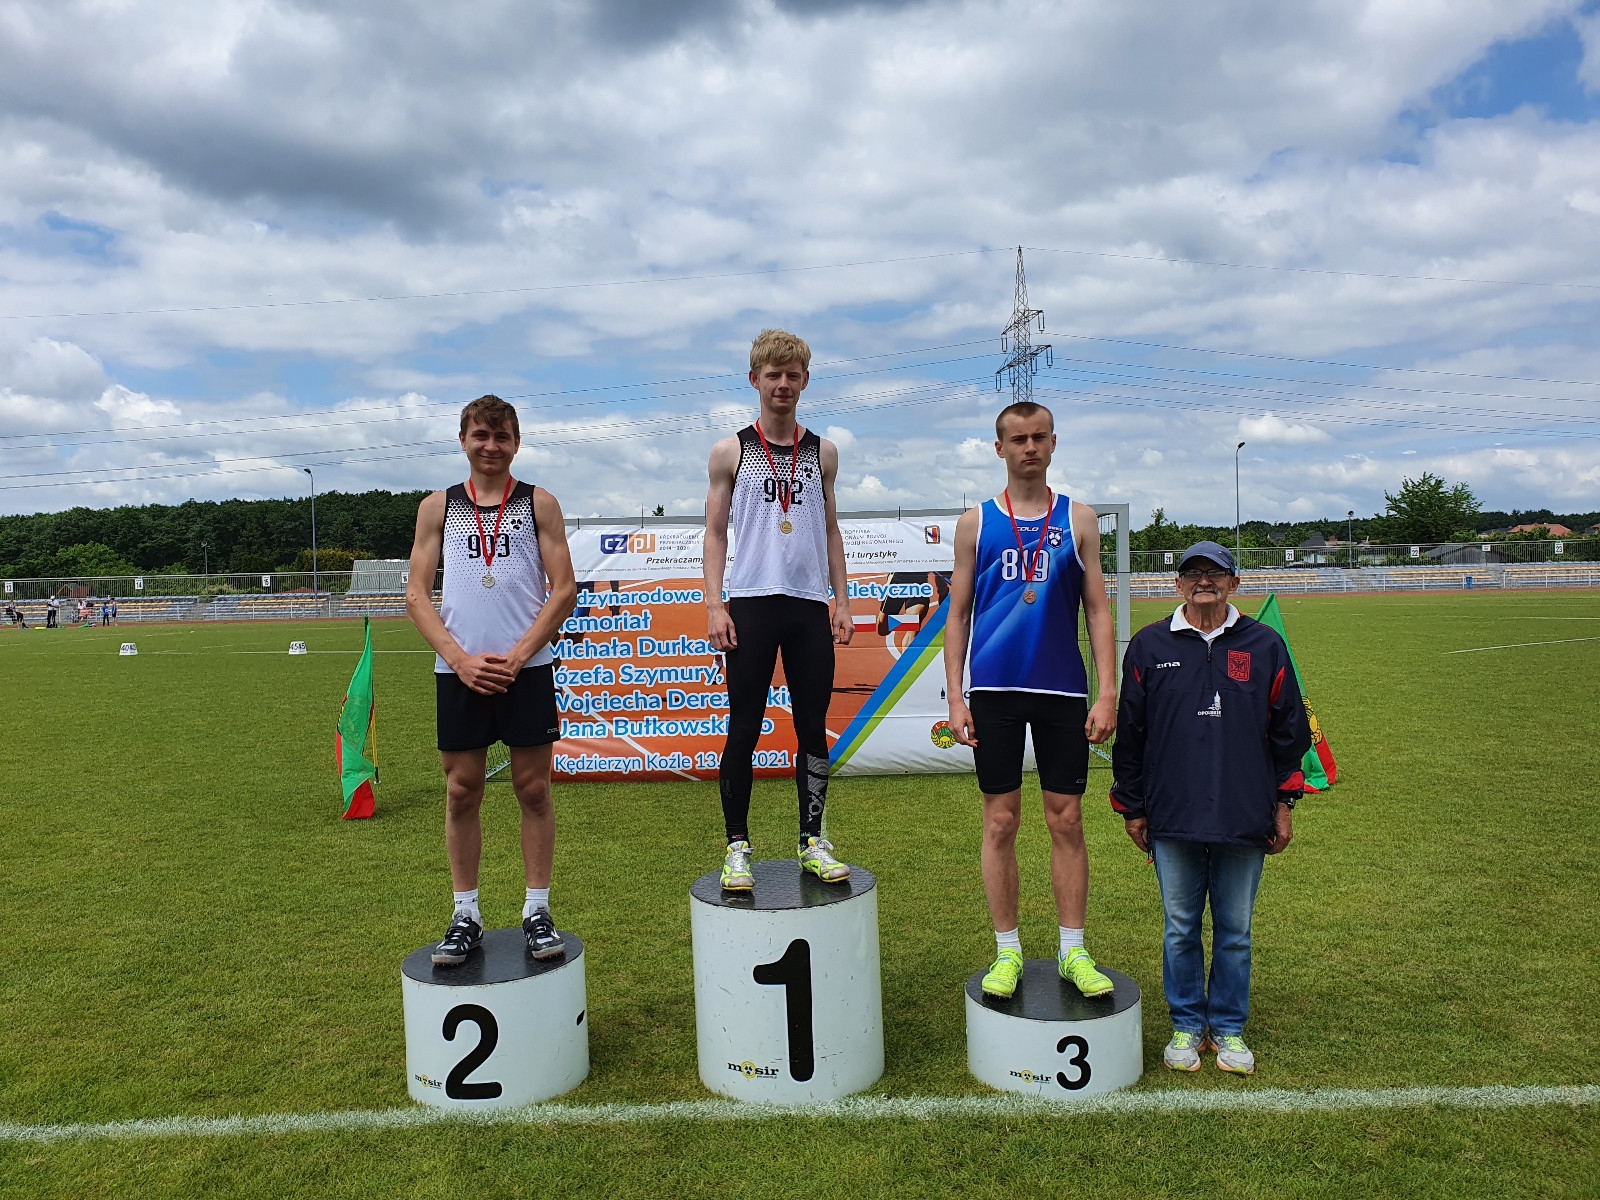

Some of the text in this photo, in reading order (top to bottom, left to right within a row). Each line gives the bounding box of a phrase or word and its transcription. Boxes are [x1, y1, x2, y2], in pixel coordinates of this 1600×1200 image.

[764, 479, 803, 504] 902
[468, 533, 510, 558] 903
[1001, 548, 1050, 582] 819
[577, 587, 702, 607] dzynarodowe
[555, 664, 724, 686] ózefa Szymury,
[556, 691, 661, 714] Wojciecha
[561, 720, 608, 737] Jana
[556, 754, 641, 773] Kędzierzyn
[647, 752, 692, 770] Koźle
[753, 938, 815, 1083] 1
[443, 1003, 503, 1099] 2
[1056, 1035, 1092, 1090] 3
